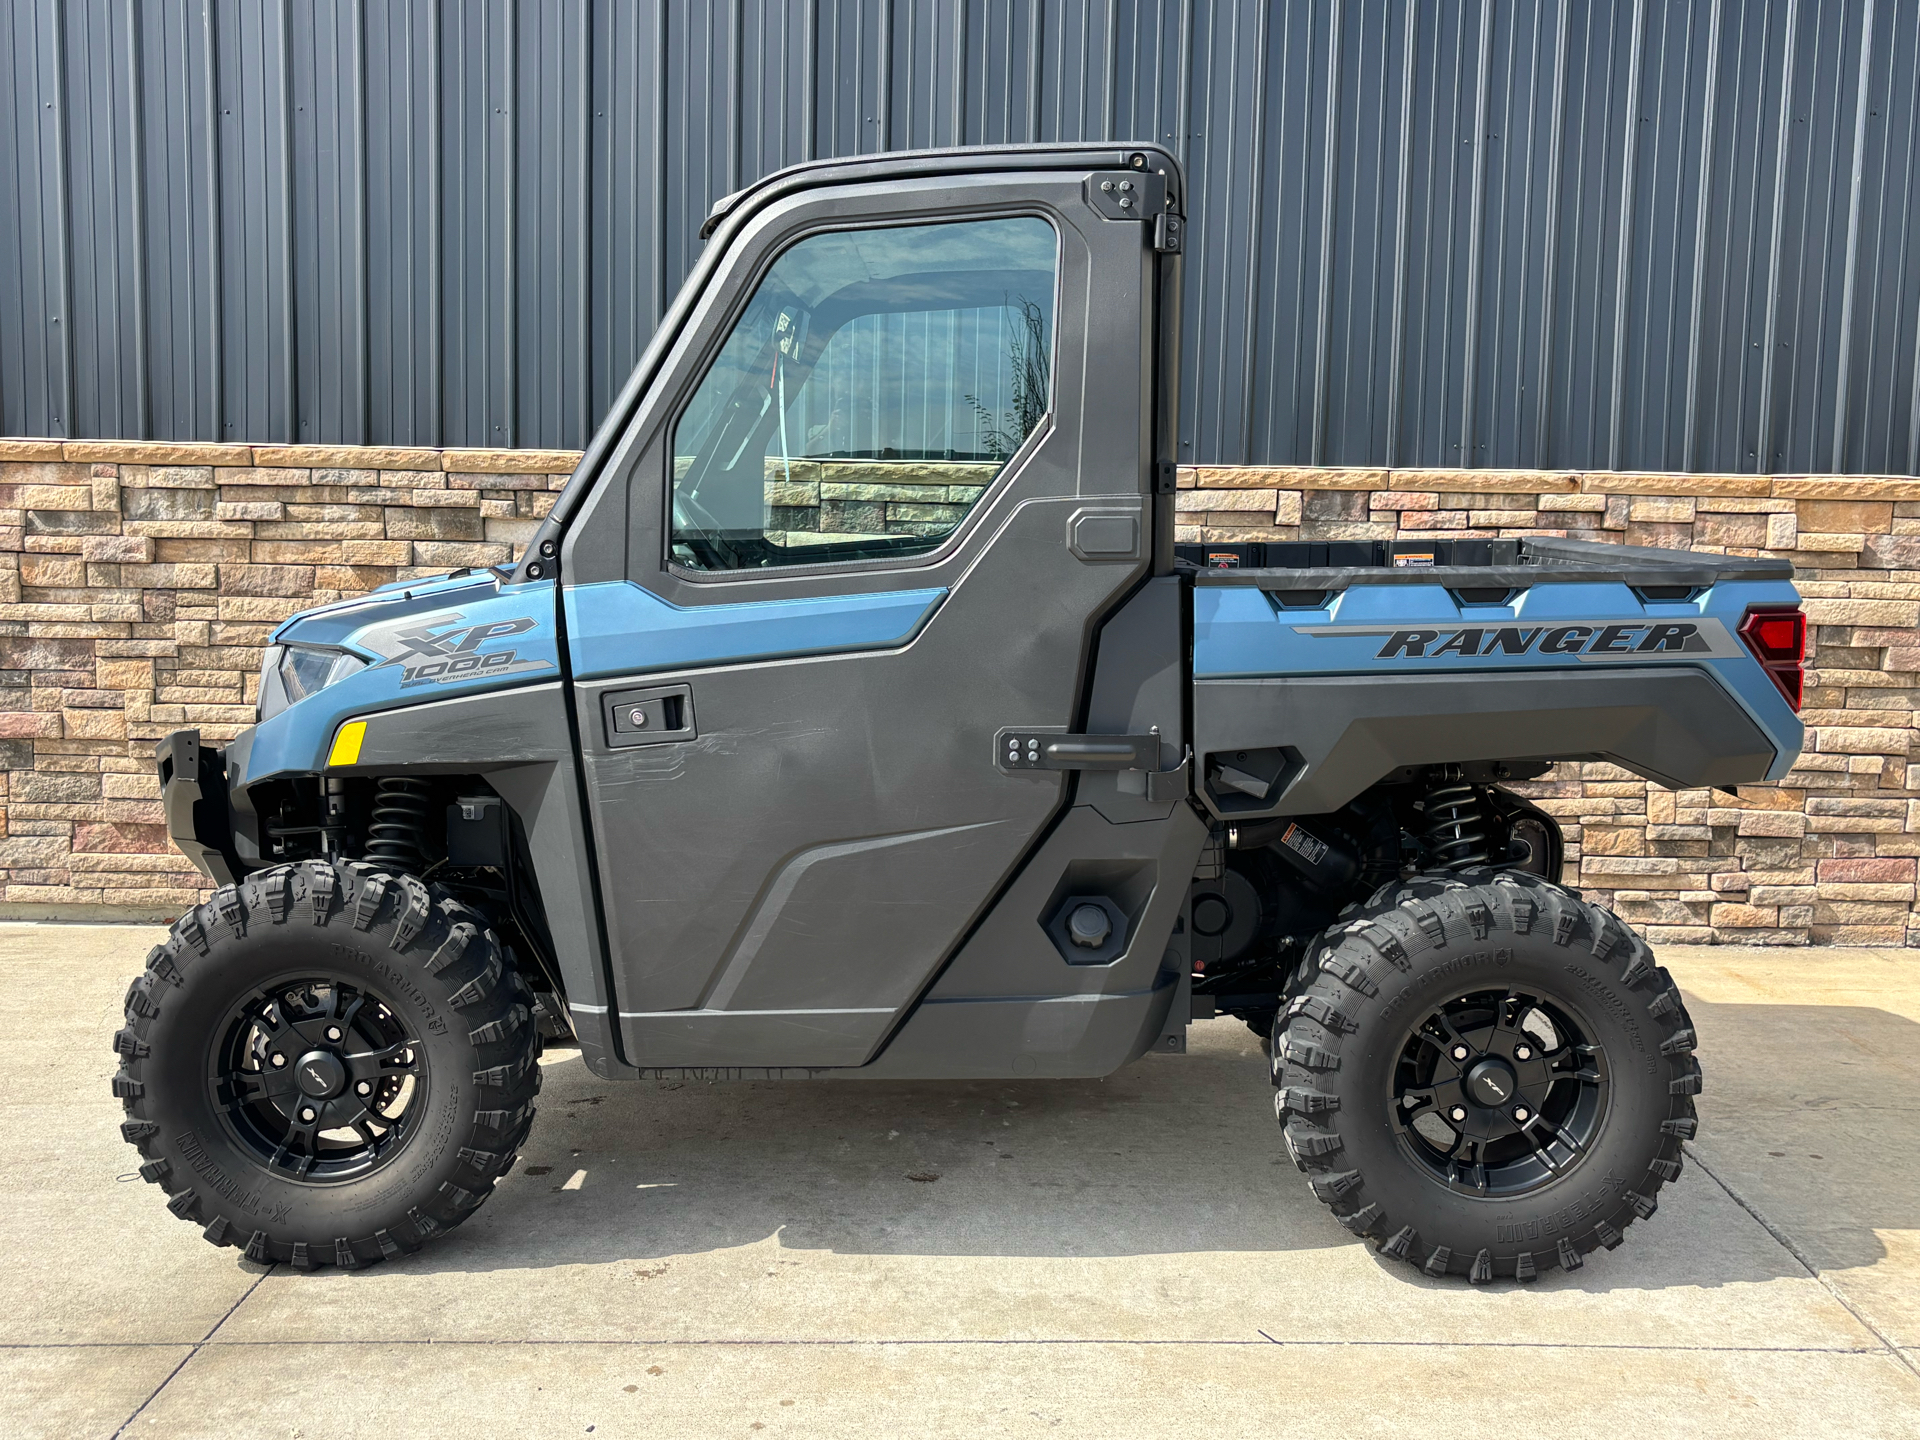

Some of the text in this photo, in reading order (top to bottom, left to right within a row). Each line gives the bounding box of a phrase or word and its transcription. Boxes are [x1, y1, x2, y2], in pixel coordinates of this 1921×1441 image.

[371, 616, 539, 669] XP
[1372, 623, 1698, 661] RANGER
[402, 649, 517, 682] 1000
[430, 670, 484, 684] OVERHEAD
[485, 666, 509, 675] CAM
[1416, 951, 1490, 990] ARMOR
[306, 1066, 328, 1088] XP
[1482, 1077, 1505, 1096] XP
[1496, 1168, 1627, 1244] X-TERRAIN
